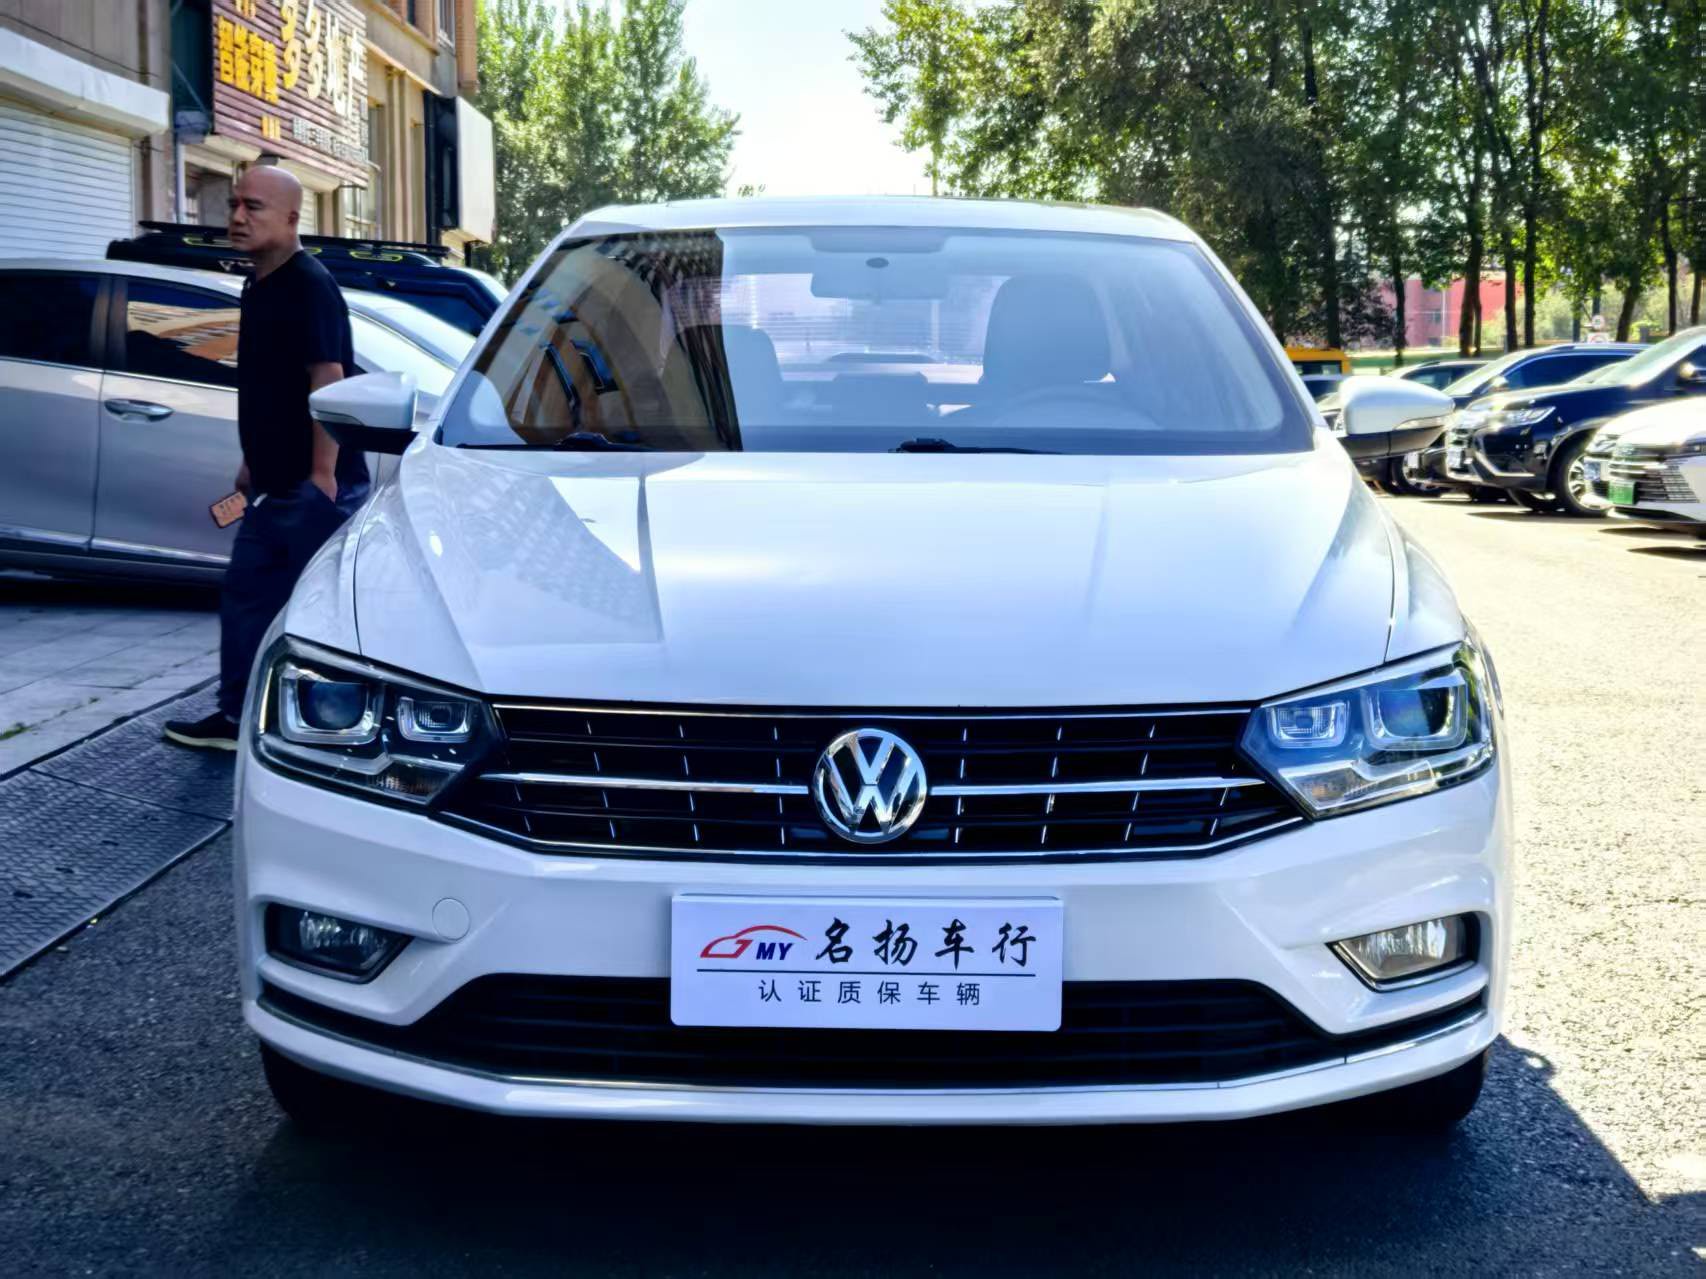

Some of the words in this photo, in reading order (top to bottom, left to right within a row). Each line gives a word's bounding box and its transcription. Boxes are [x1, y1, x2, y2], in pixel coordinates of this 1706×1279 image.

[756, 941, 793, 961] MY
[815, 917, 1036, 971] 名扬车行
[758, 979, 980, 1006] 认证质保车辆
